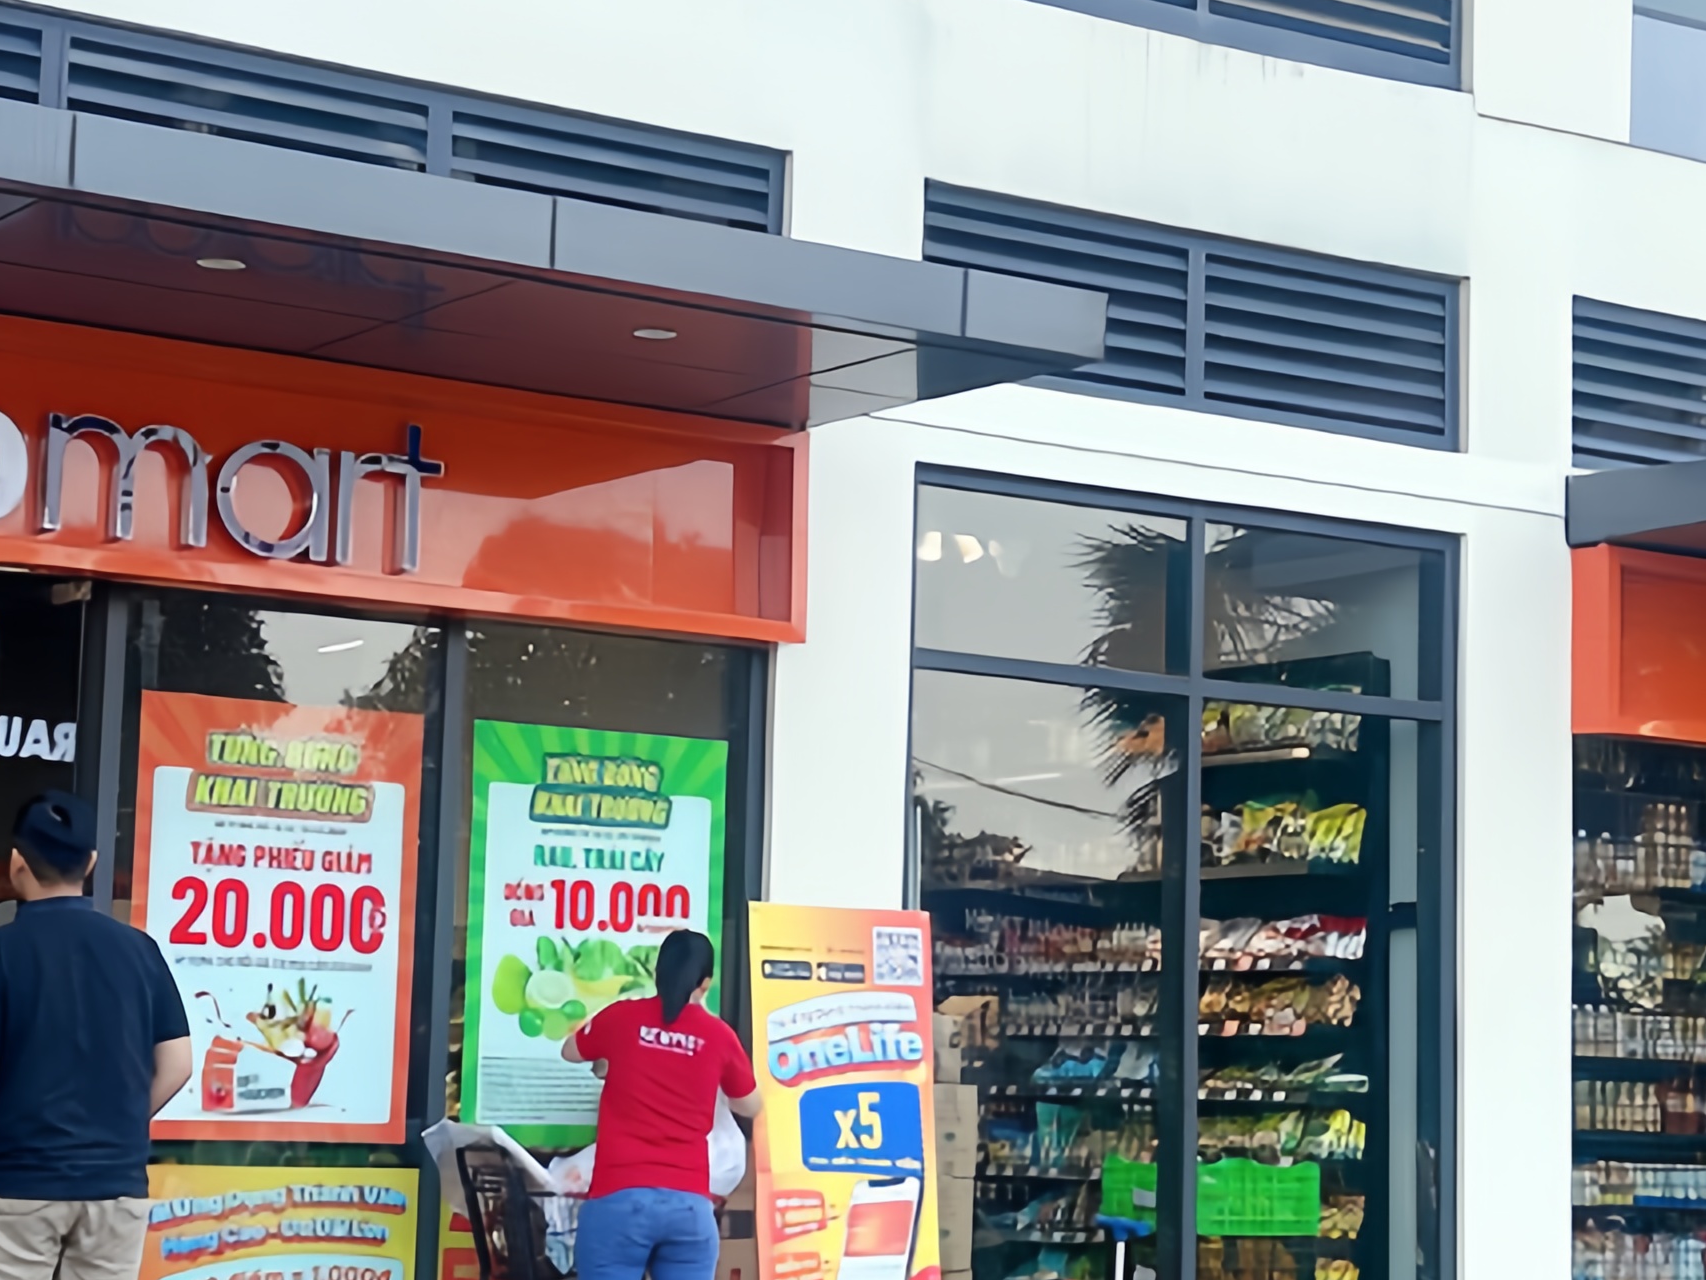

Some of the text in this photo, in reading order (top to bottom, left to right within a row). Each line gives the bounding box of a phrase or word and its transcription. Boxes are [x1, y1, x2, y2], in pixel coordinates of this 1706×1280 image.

[43, 412, 445, 574] mart
[768, 1023, 924, 1081] OneLife
[834, 1092, 883, 1149] x5
